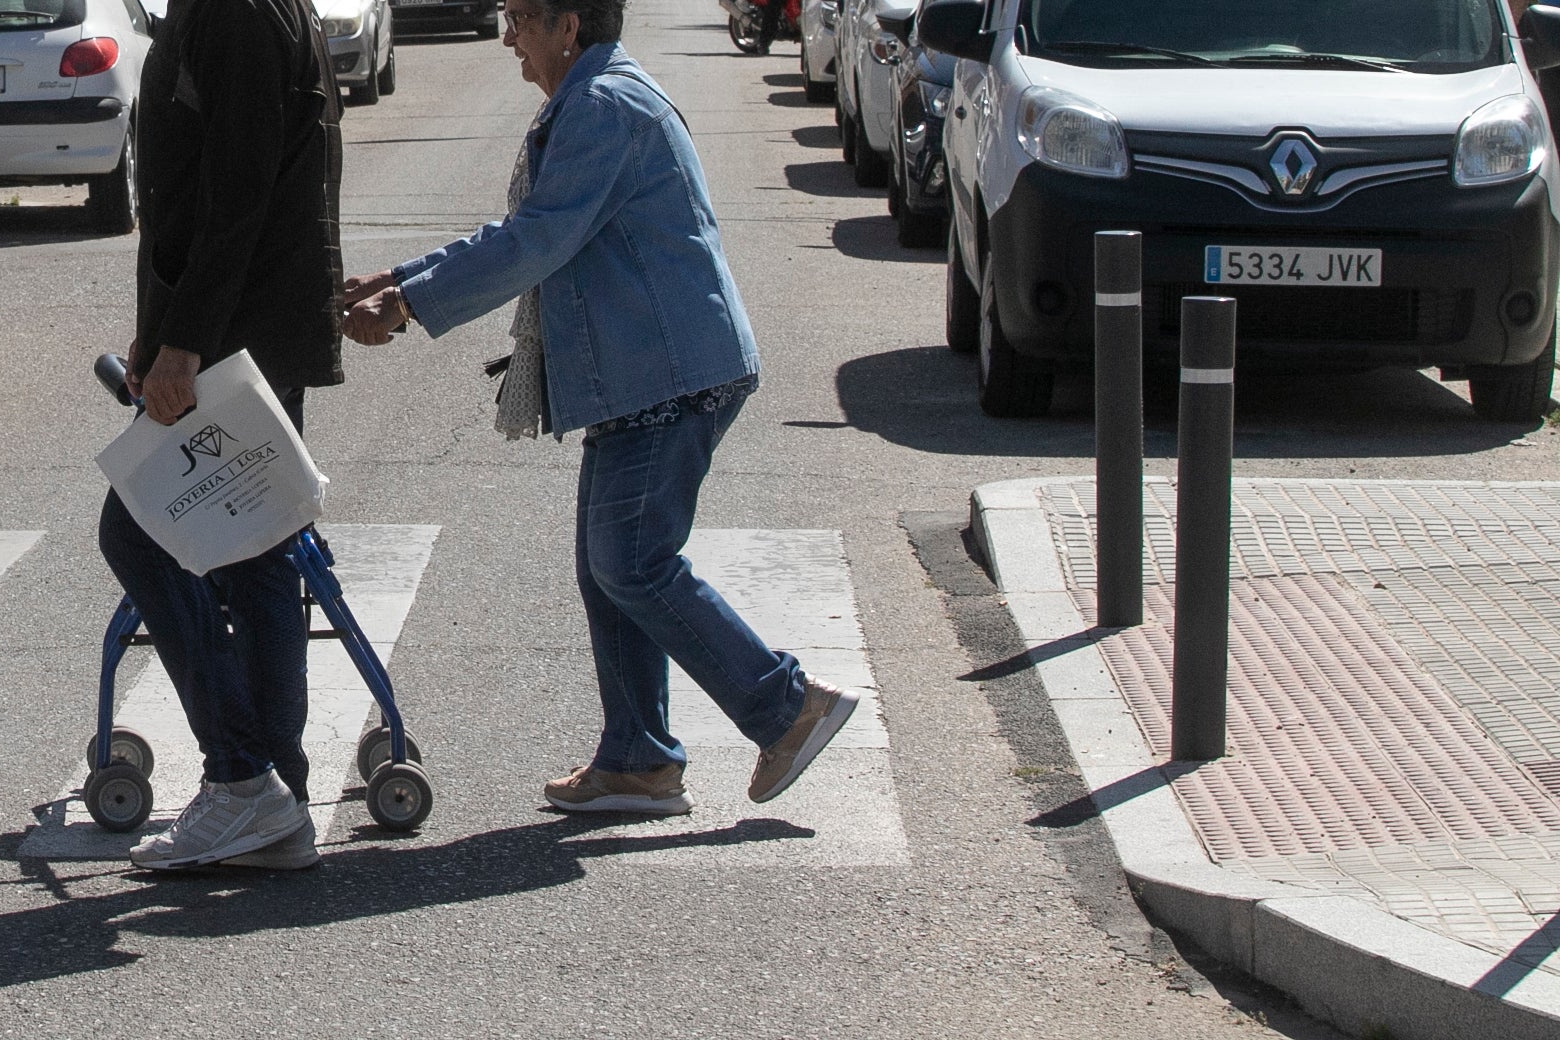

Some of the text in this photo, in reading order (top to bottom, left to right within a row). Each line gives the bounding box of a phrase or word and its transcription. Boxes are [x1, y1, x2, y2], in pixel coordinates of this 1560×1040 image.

[1210, 268, 1217, 277] E
[1227, 251, 1374, 282] 5334 JVK
[168, 474, 226, 520] JOYERIA
